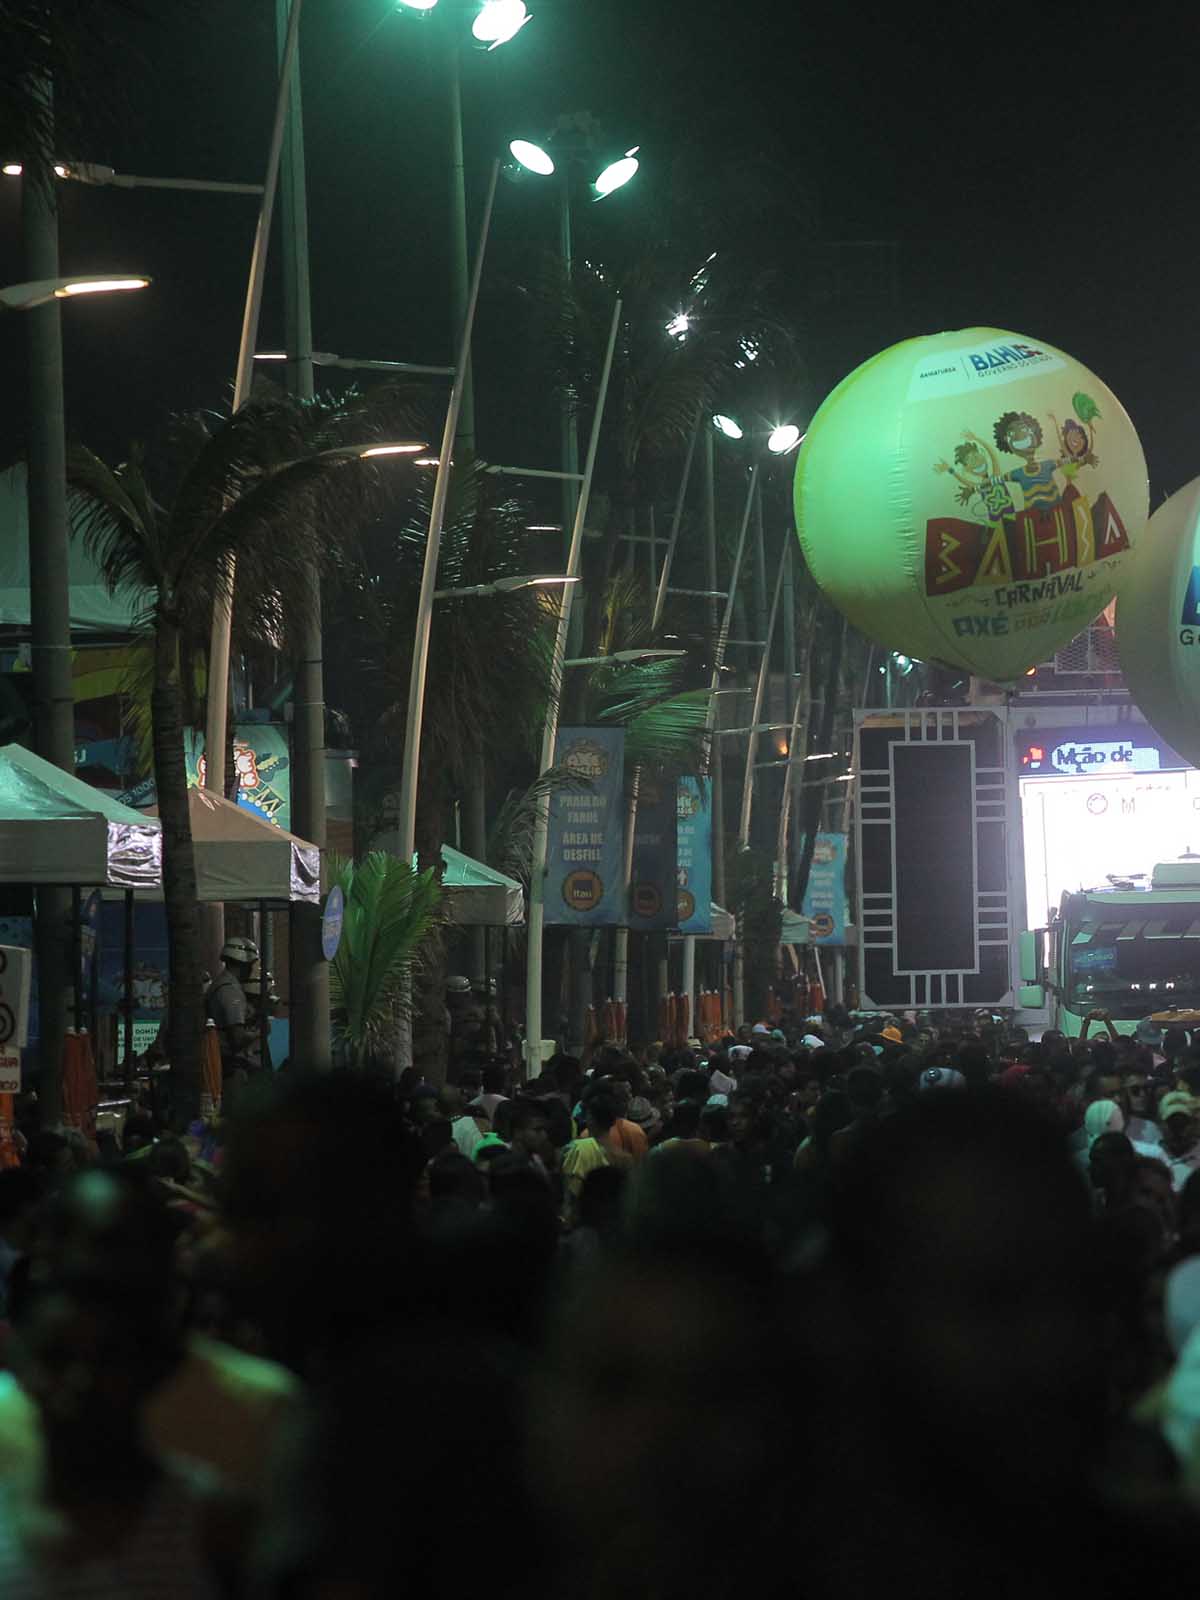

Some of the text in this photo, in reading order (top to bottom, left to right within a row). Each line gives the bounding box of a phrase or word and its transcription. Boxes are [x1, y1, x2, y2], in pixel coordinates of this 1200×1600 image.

[969, 345, 1037, 372] BAHIA
[925, 485, 1130, 597] BAHIA
[994, 569, 1084, 609] CARNAVAL
[952, 611, 1009, 637] AXÉ
